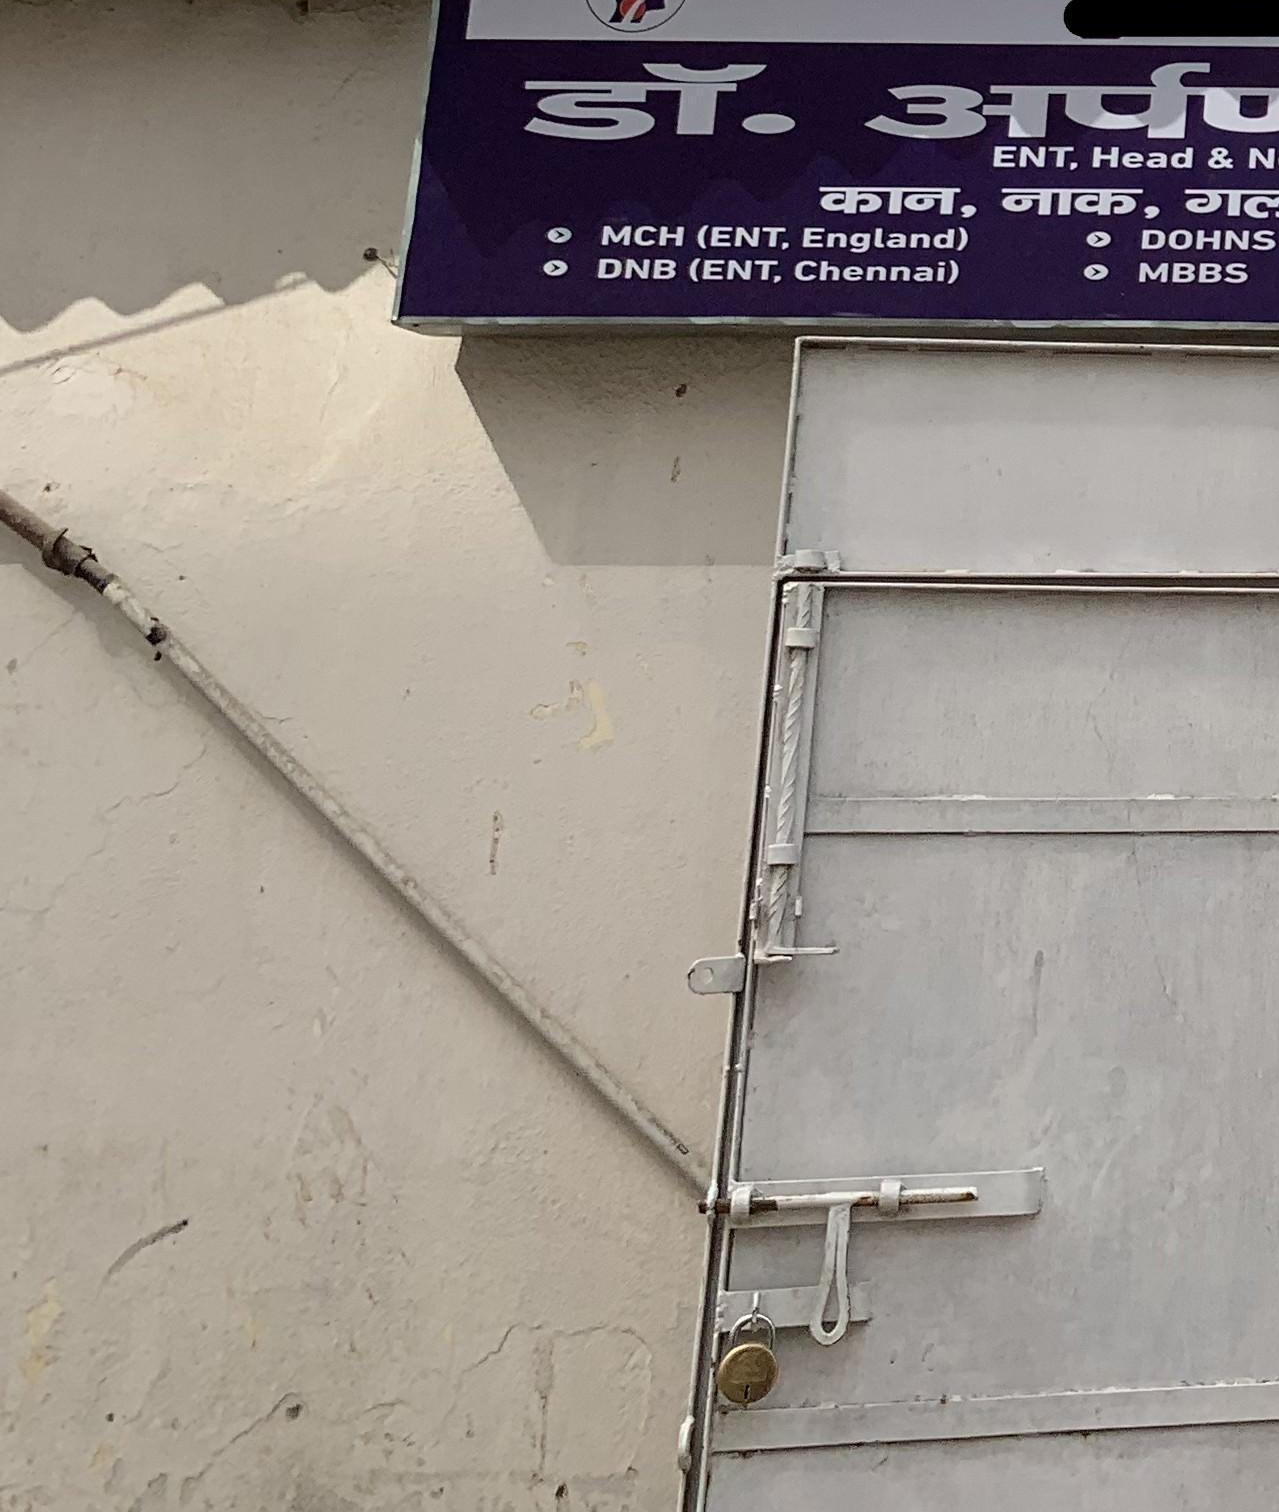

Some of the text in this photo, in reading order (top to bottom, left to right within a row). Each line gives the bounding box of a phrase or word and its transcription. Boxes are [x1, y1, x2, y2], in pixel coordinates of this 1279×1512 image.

[525, 63, 795, 140] डॉ.
[993, 146, 1077, 170] ENT,
[1092, 147, 1193, 169] Head
[1208, 148, 1233, 169] &
[819, 187, 976, 218] कान,
[1002, 187, 1160, 219] नाक,
[602, 225, 969, 252] MCH (ENT, England)
[1141, 230, 1276, 251] DOHNS
[597, 258, 959, 285] DNB (ENT, Chennai)
[1138, 263, 1249, 284] MBBS
